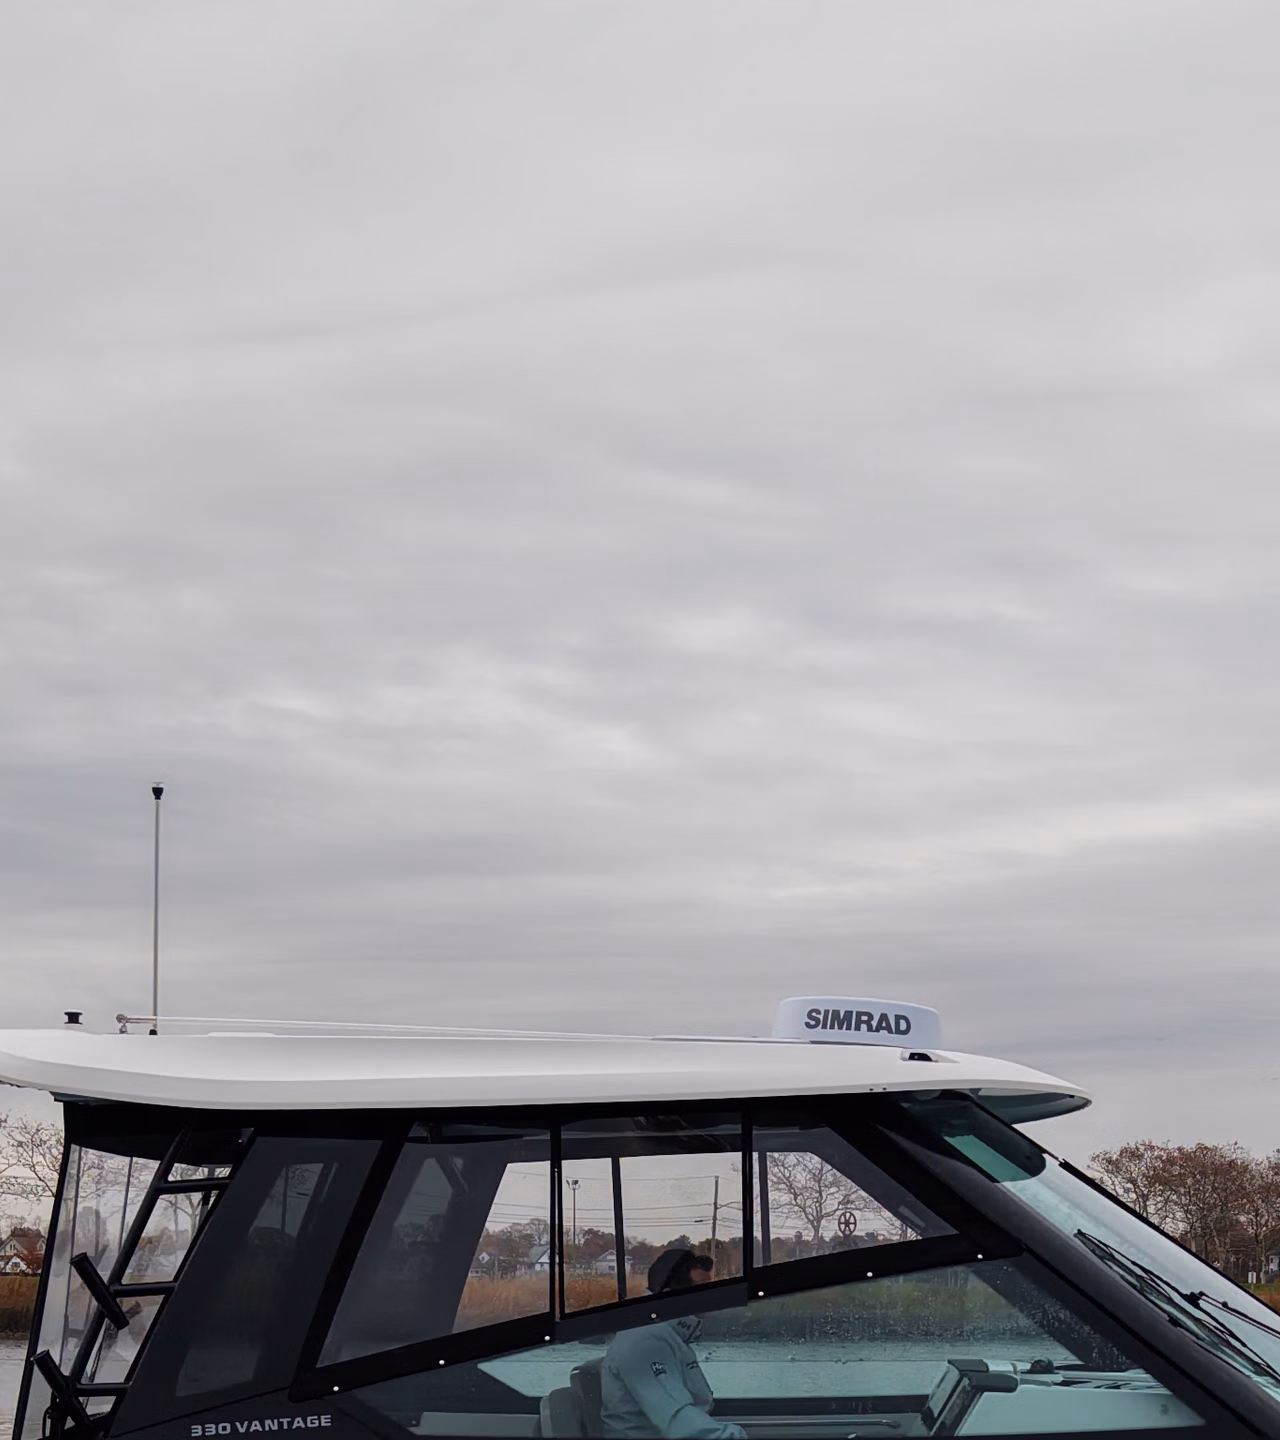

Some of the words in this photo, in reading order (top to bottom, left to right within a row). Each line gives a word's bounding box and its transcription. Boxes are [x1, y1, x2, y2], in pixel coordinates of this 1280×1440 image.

[804, 1008, 911, 1035] SIMRAD
[191, 1422, 231, 1437] 330
[235, 1414, 331, 1433] VANTAGE
